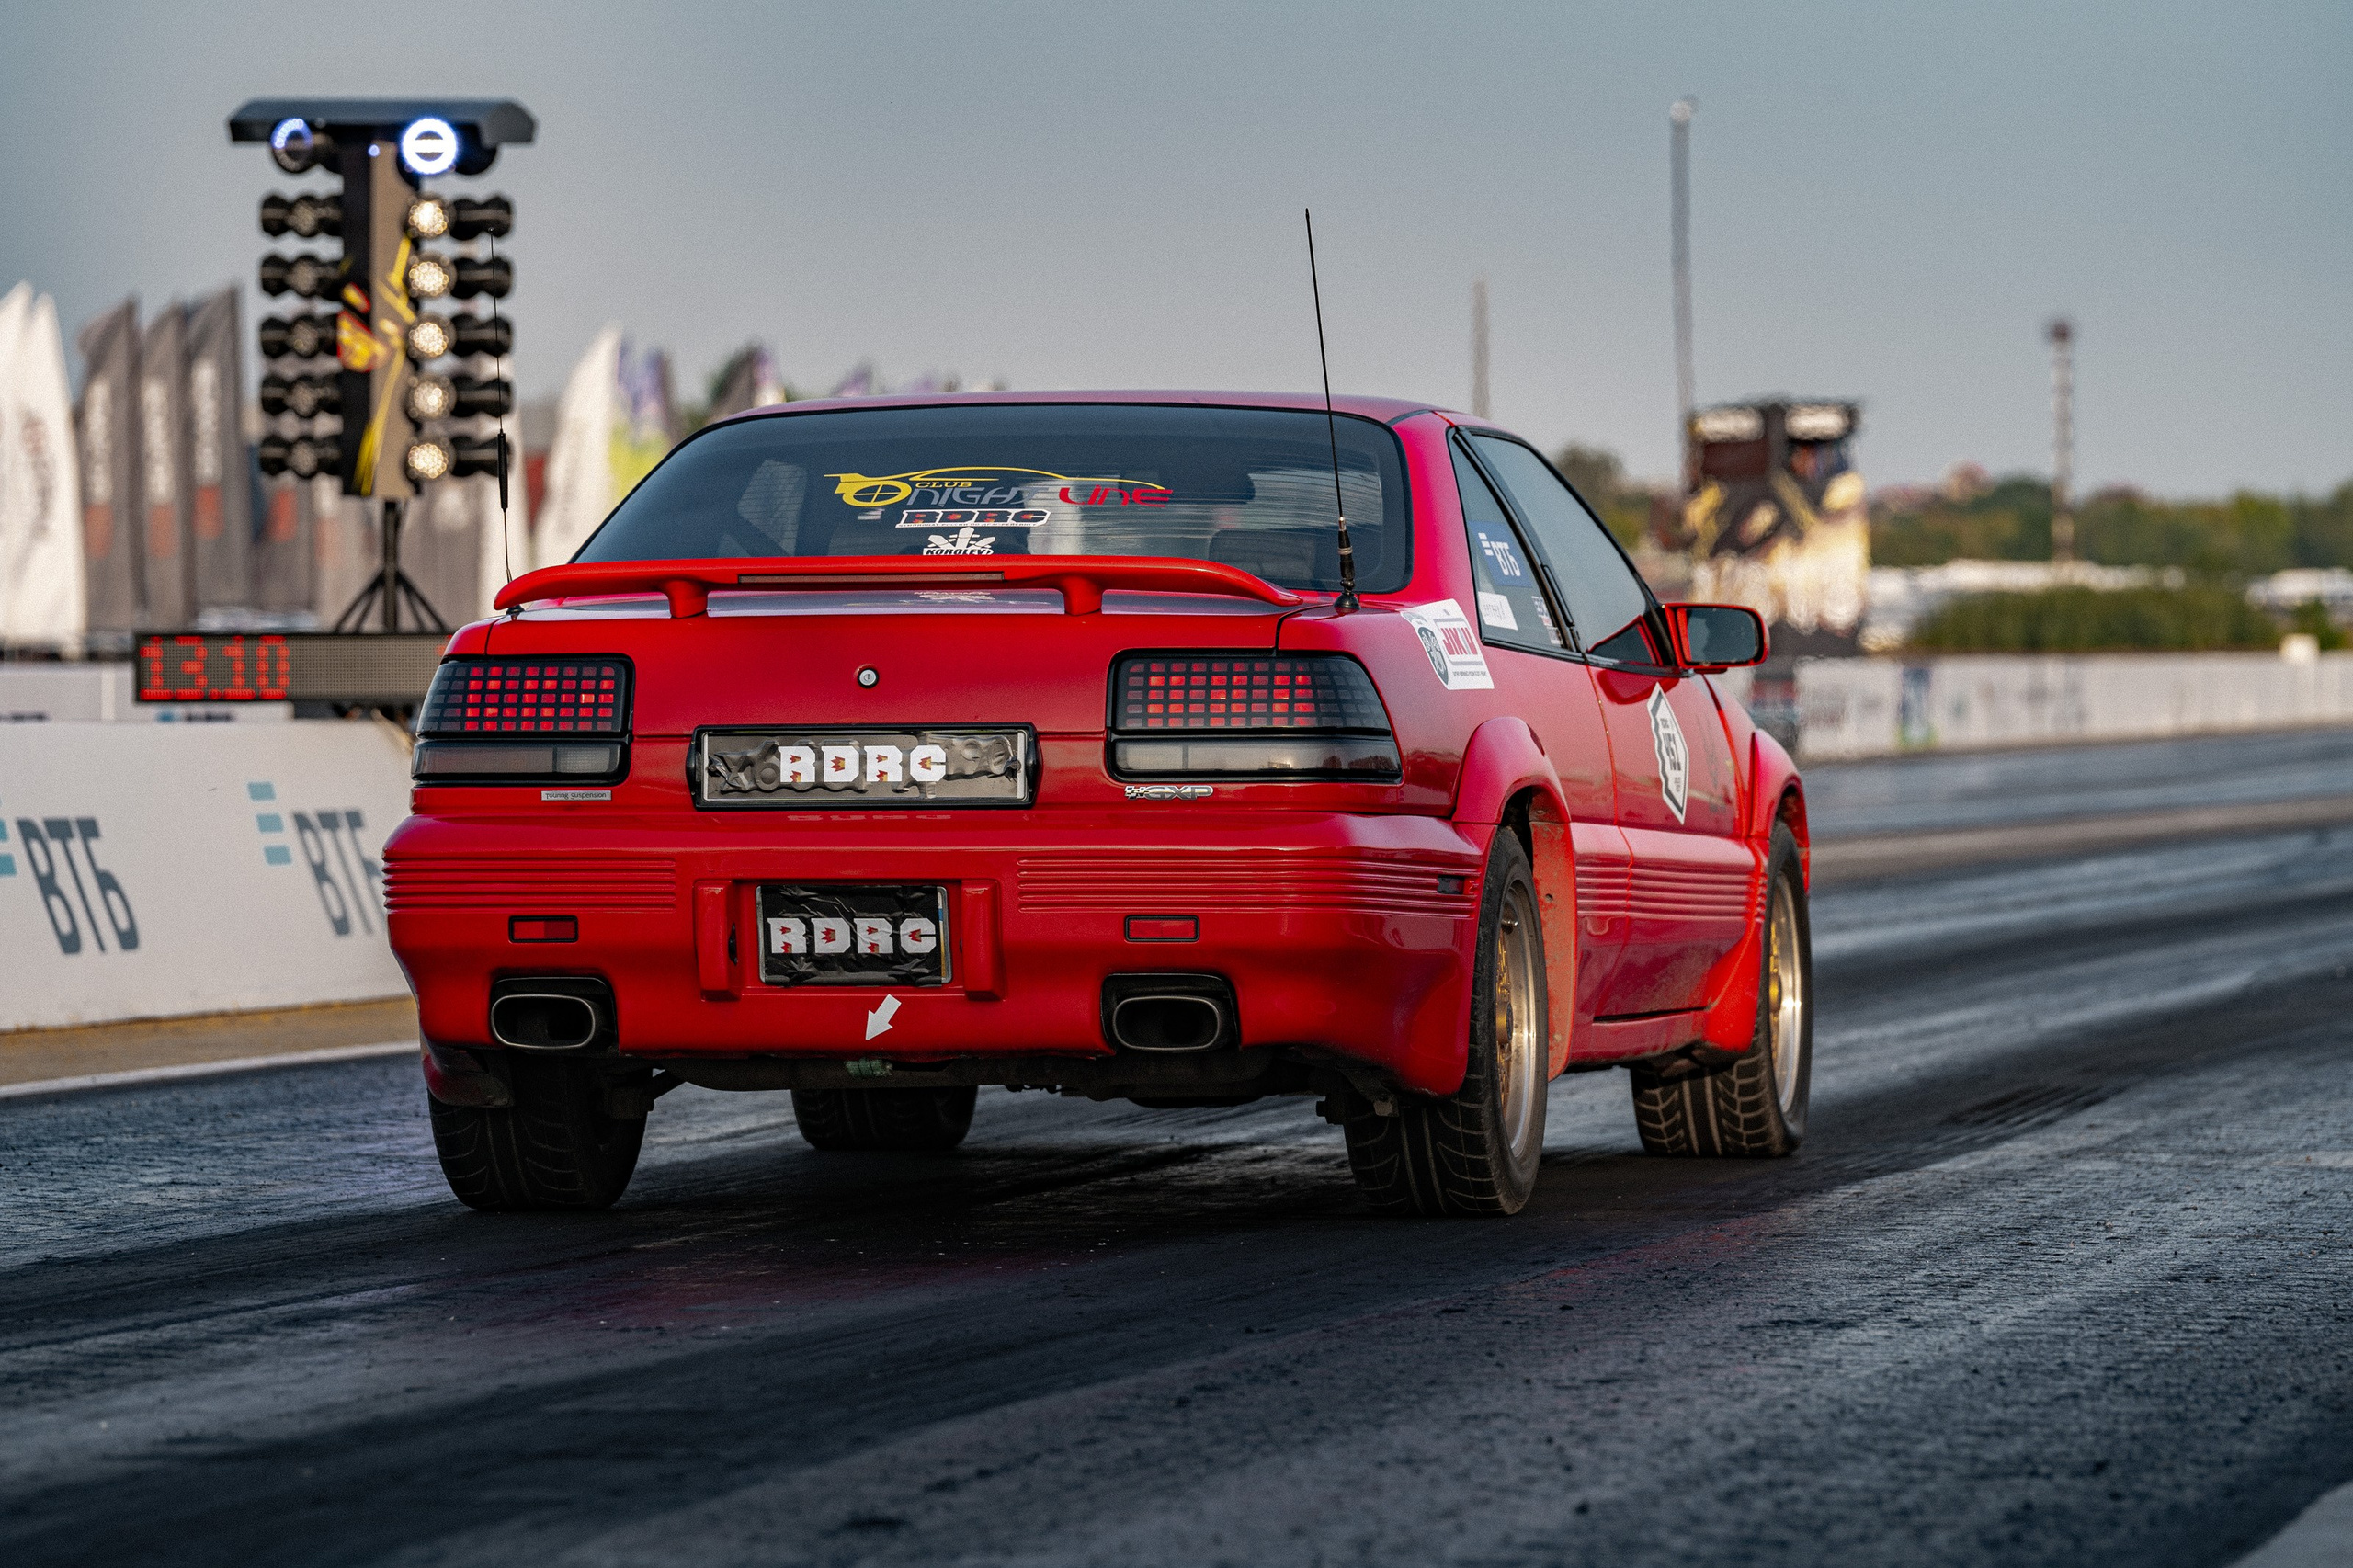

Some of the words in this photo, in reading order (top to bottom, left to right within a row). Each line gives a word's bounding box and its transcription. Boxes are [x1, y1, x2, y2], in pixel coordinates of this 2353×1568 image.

[900, 508, 1051, 525] RDRC
[1490, 541, 1521, 577] ВТБ
[140, 636, 290, 700] 13.10
[778, 744, 947, 783] RDRC
[1144, 785, 1213, 800] GXP
[16, 817, 140, 955] ВТБ
[767, 917, 937, 954] RDRC
